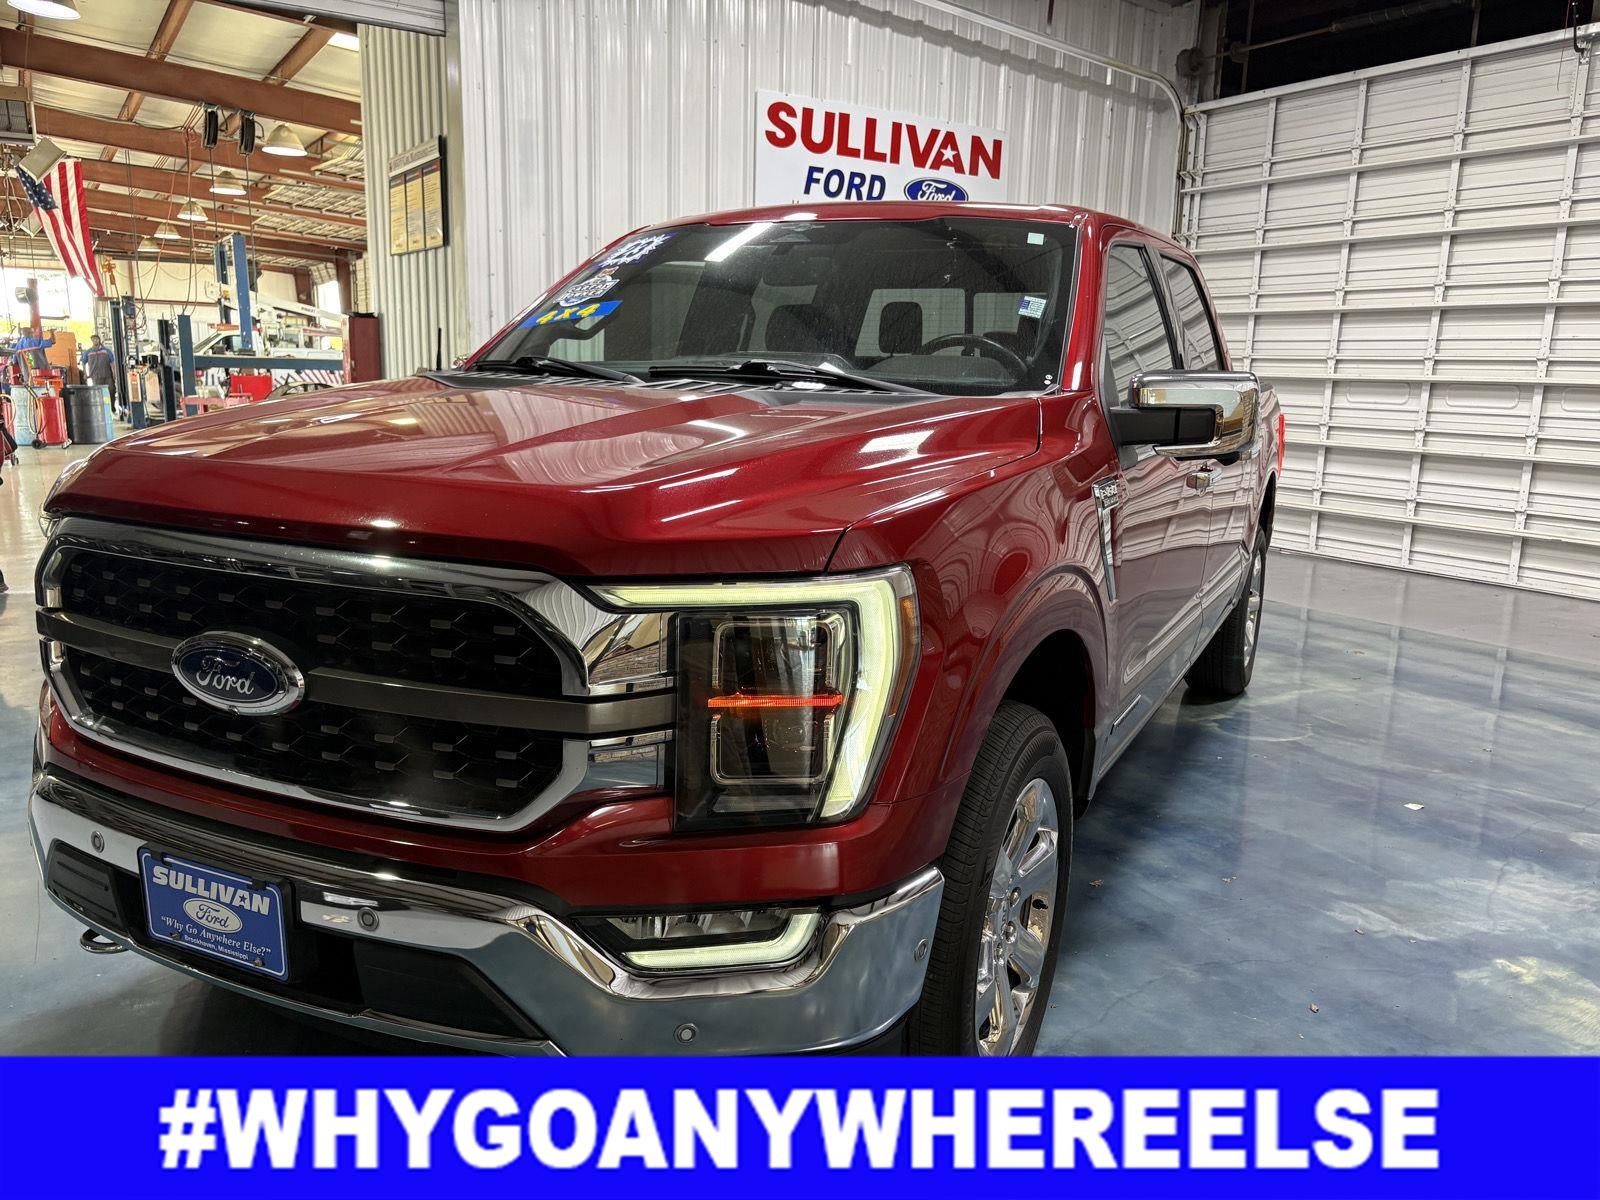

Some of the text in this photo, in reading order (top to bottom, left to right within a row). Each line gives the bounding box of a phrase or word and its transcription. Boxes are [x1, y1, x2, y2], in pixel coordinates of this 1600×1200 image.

[764, 101, 1003, 180] SULLIVAN
[803, 166, 886, 200] FORD
[195, 655, 255, 695] Ford
[152, 865, 270, 916] SULLIVAN
[195, 903, 230, 928] Ford
[185, 923, 198, 935] Go
[199, 928, 241, 949] Anywhere
